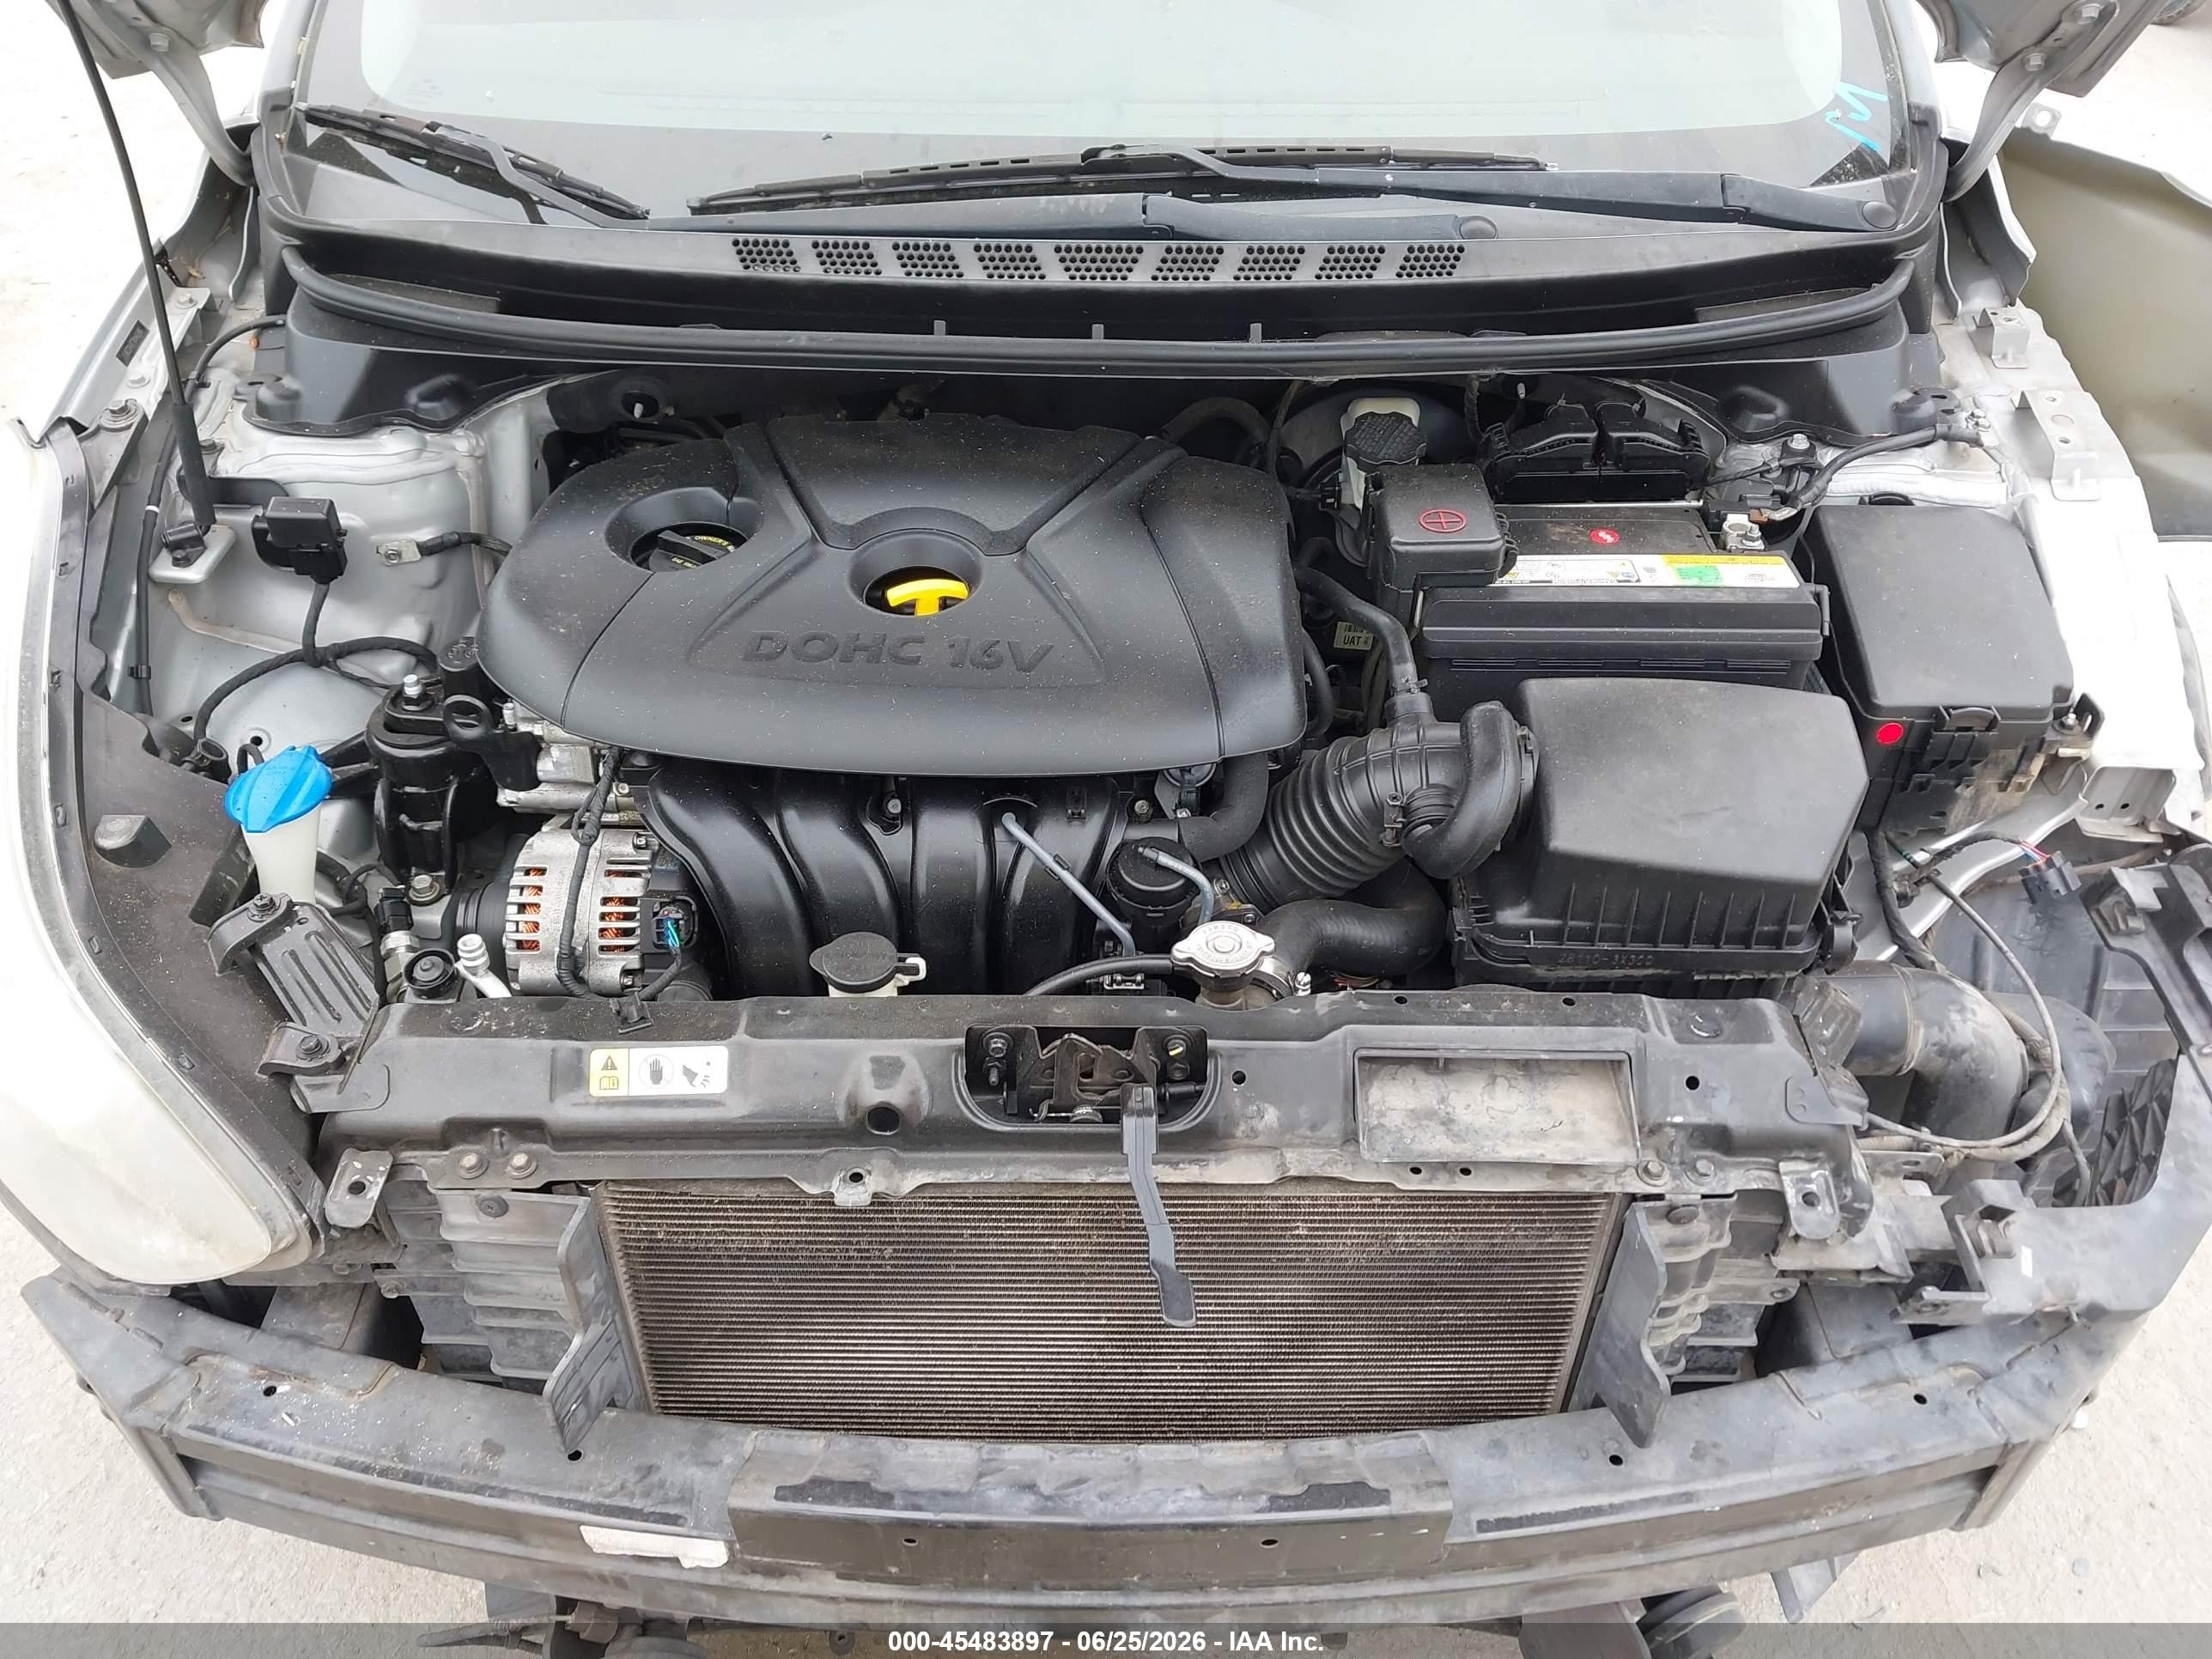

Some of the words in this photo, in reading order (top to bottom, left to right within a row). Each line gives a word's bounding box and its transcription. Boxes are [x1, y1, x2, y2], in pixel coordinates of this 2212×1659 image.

[742, 630, 926, 665] DOHC
[947, 635, 1055, 672] 16V
[1343, 635, 1363, 646] UAT
